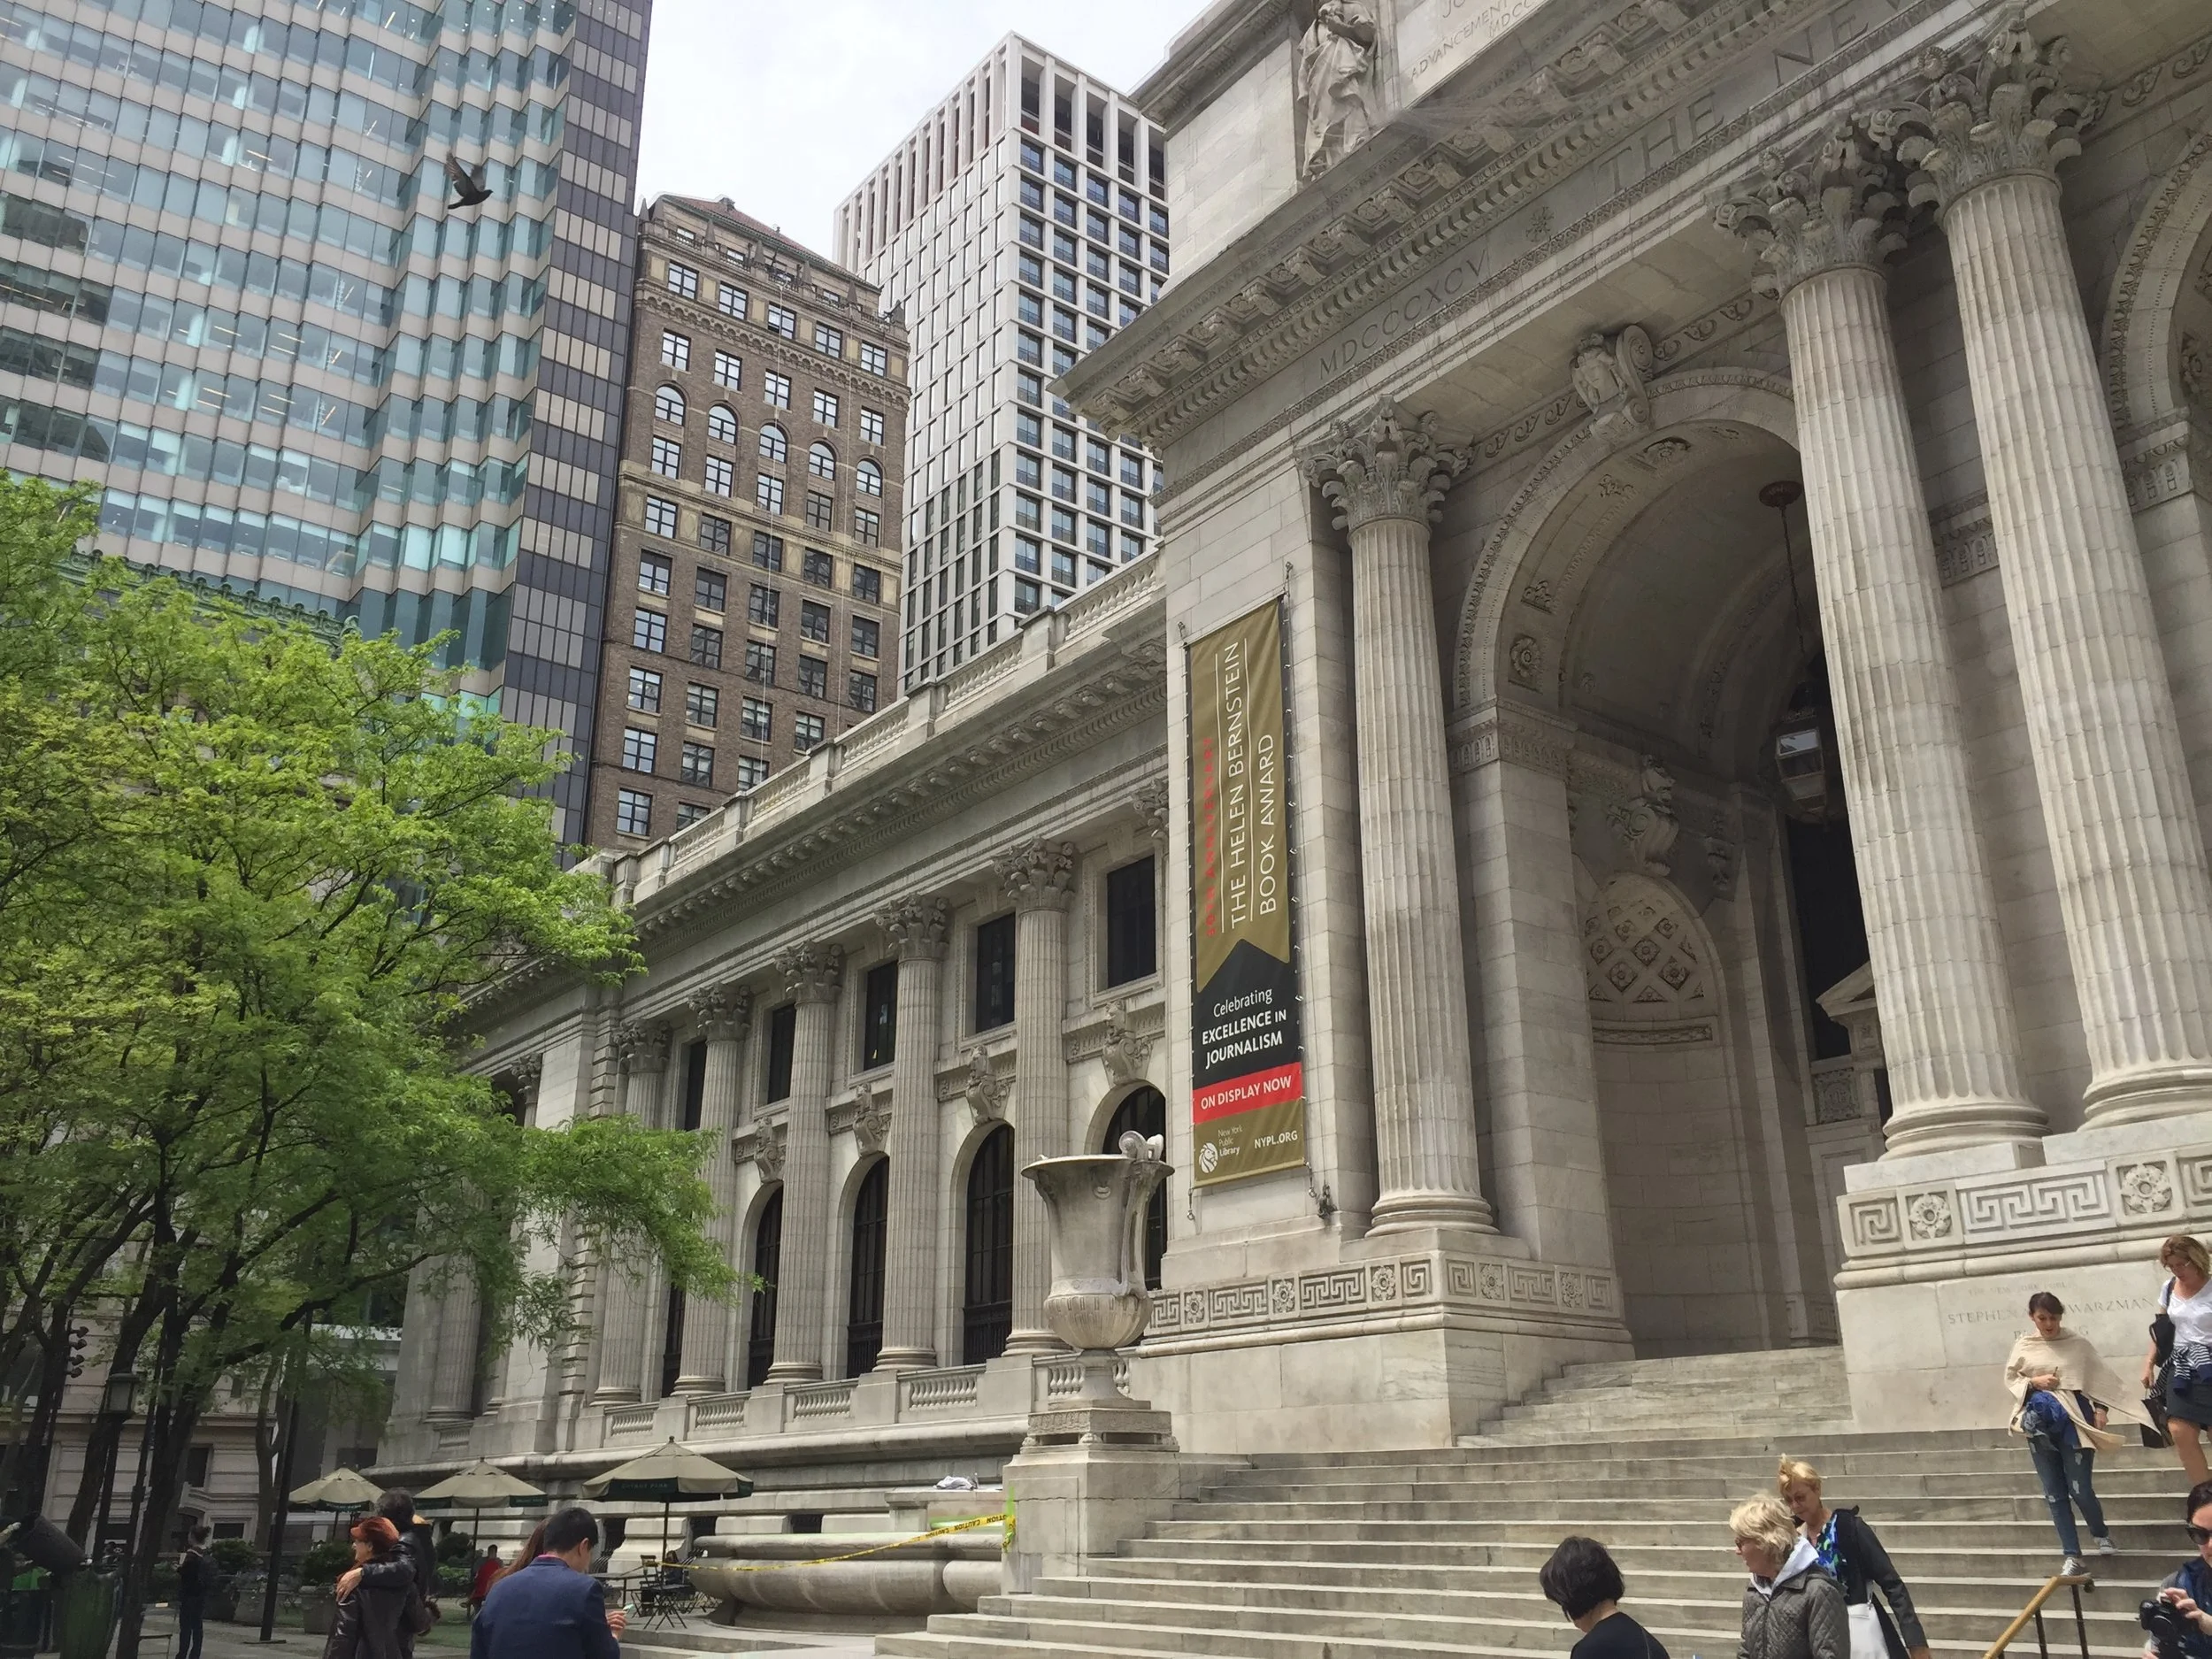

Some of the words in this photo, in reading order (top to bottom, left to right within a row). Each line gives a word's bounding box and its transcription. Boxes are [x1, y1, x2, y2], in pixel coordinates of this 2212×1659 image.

[1319, 249, 1486, 380] MDCCCXCV
[1596, 90, 1724, 195] THE
[1225, 641, 1245, 778] BERNSTEIN
[1258, 734, 1274, 826] AWARD
[1229, 784, 1245, 869] HELEN
[1259, 834, 1277, 915] BOOK
[1231, 874, 1246, 929] THE
[1213, 988, 1273, 1018] Celebrating
[1202, 1010, 1271, 1045] EXCELLENCE
[1274, 1009, 1286, 1023] IN
[1205, 1030, 1283, 1070] JOURNALISM
[1201, 1094, 1216, 1110] ON
[1217, 1083, 1261, 1105] DISPLAY
[1263, 1075, 1292, 1094] NOW
[1218, 1137, 1234, 1147] Public
[1231, 1125, 1243, 1133] York
[1254, 1130, 1298, 1148] NYPL.ORG
[1219, 1146, 1240, 1156] Library
[2065, 1298, 2155, 1313] WARZMAN
[954, 1519, 980, 1532] CAUTION
